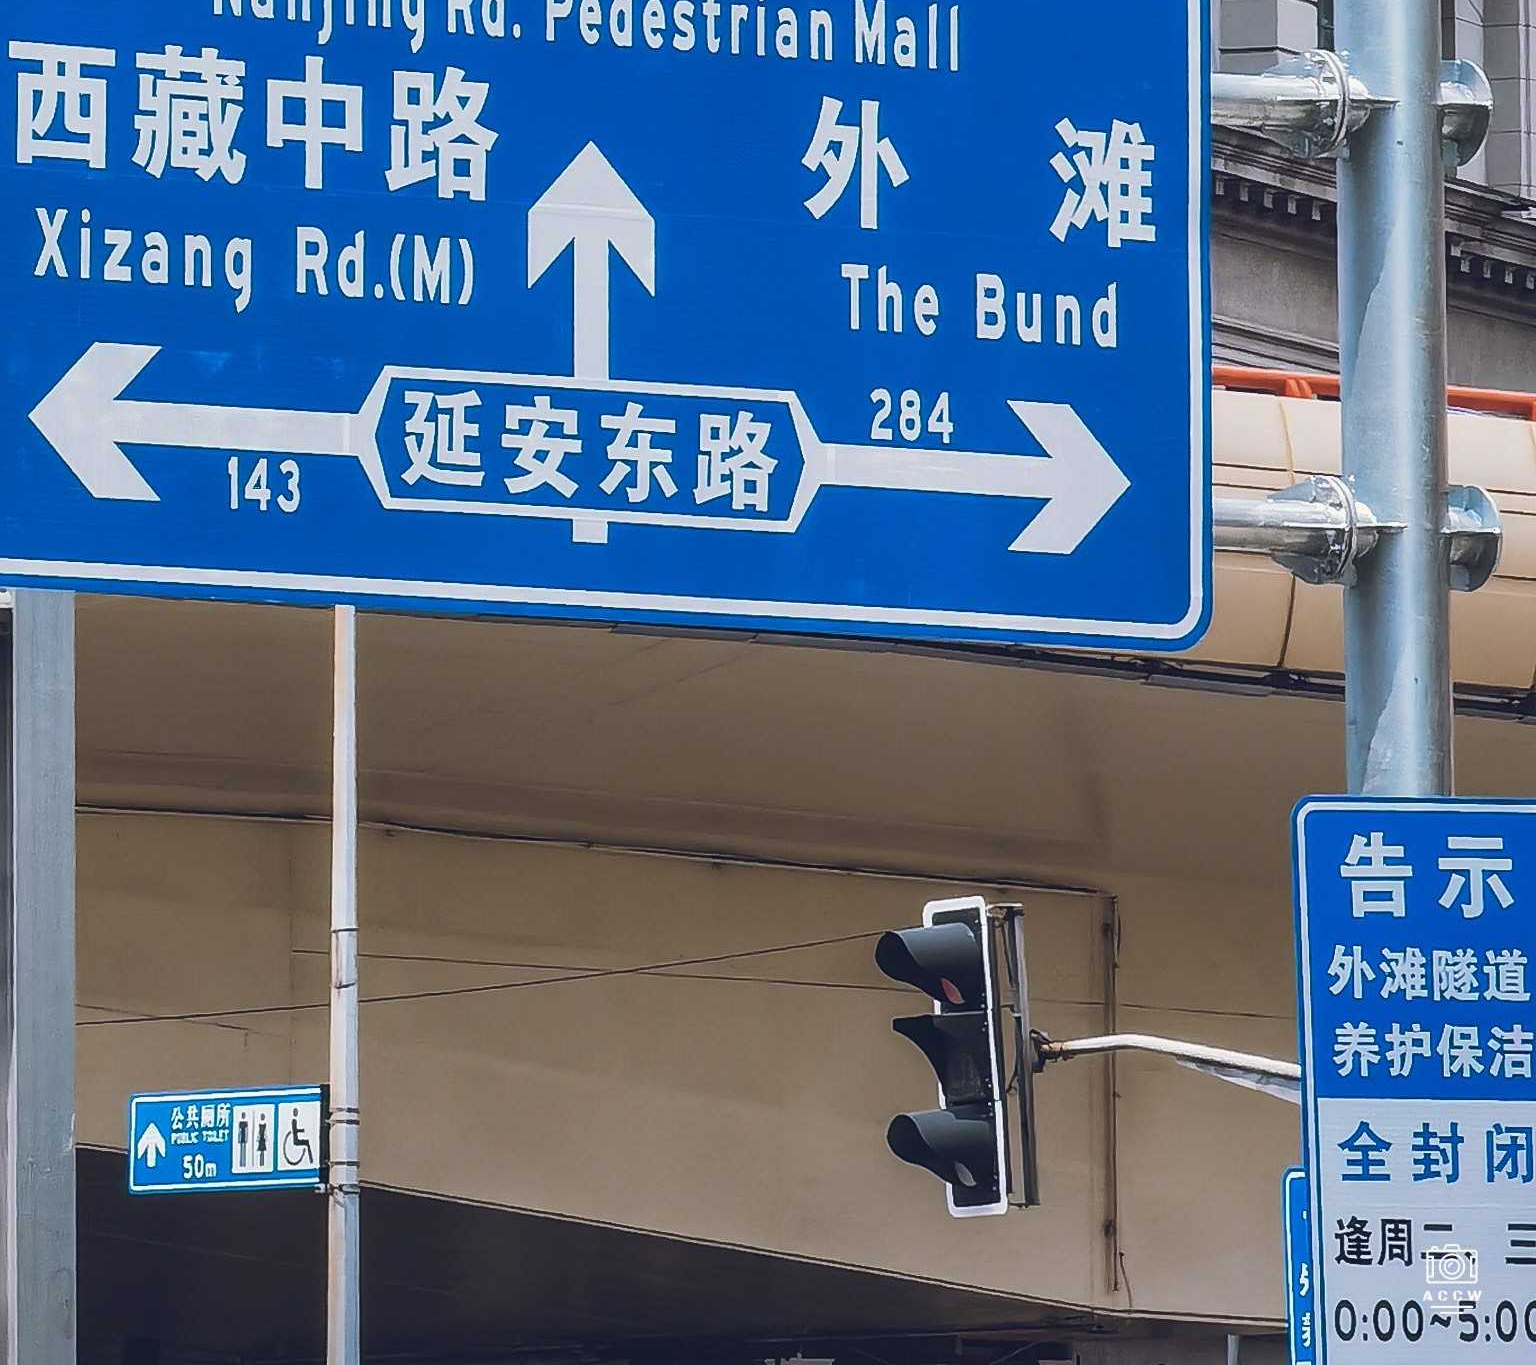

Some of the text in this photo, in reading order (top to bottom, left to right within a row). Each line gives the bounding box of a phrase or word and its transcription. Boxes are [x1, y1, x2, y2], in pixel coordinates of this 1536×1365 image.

[8, 39, 500, 202] 西藏中路
[801, 95, 1157, 249] 外滩
[34, 207, 475, 314] Xizang Rd.(M)
[841, 263, 1119, 349] The Bund
[870, 388, 954, 445] 284
[401, 390, 780, 512] 延安东路
[226, 456, 302, 514] 143
[1340, 831, 1515, 919] 告示
[1327, 944, 1531, 1001] 外滩隧道
[1332, 1021, 1535, 1078] 养护保洁
[170, 1102, 231, 1130] 公共厕所
[182, 1153, 217, 1179] 50m
[1336, 1120, 1535, 1184] 全封闭
